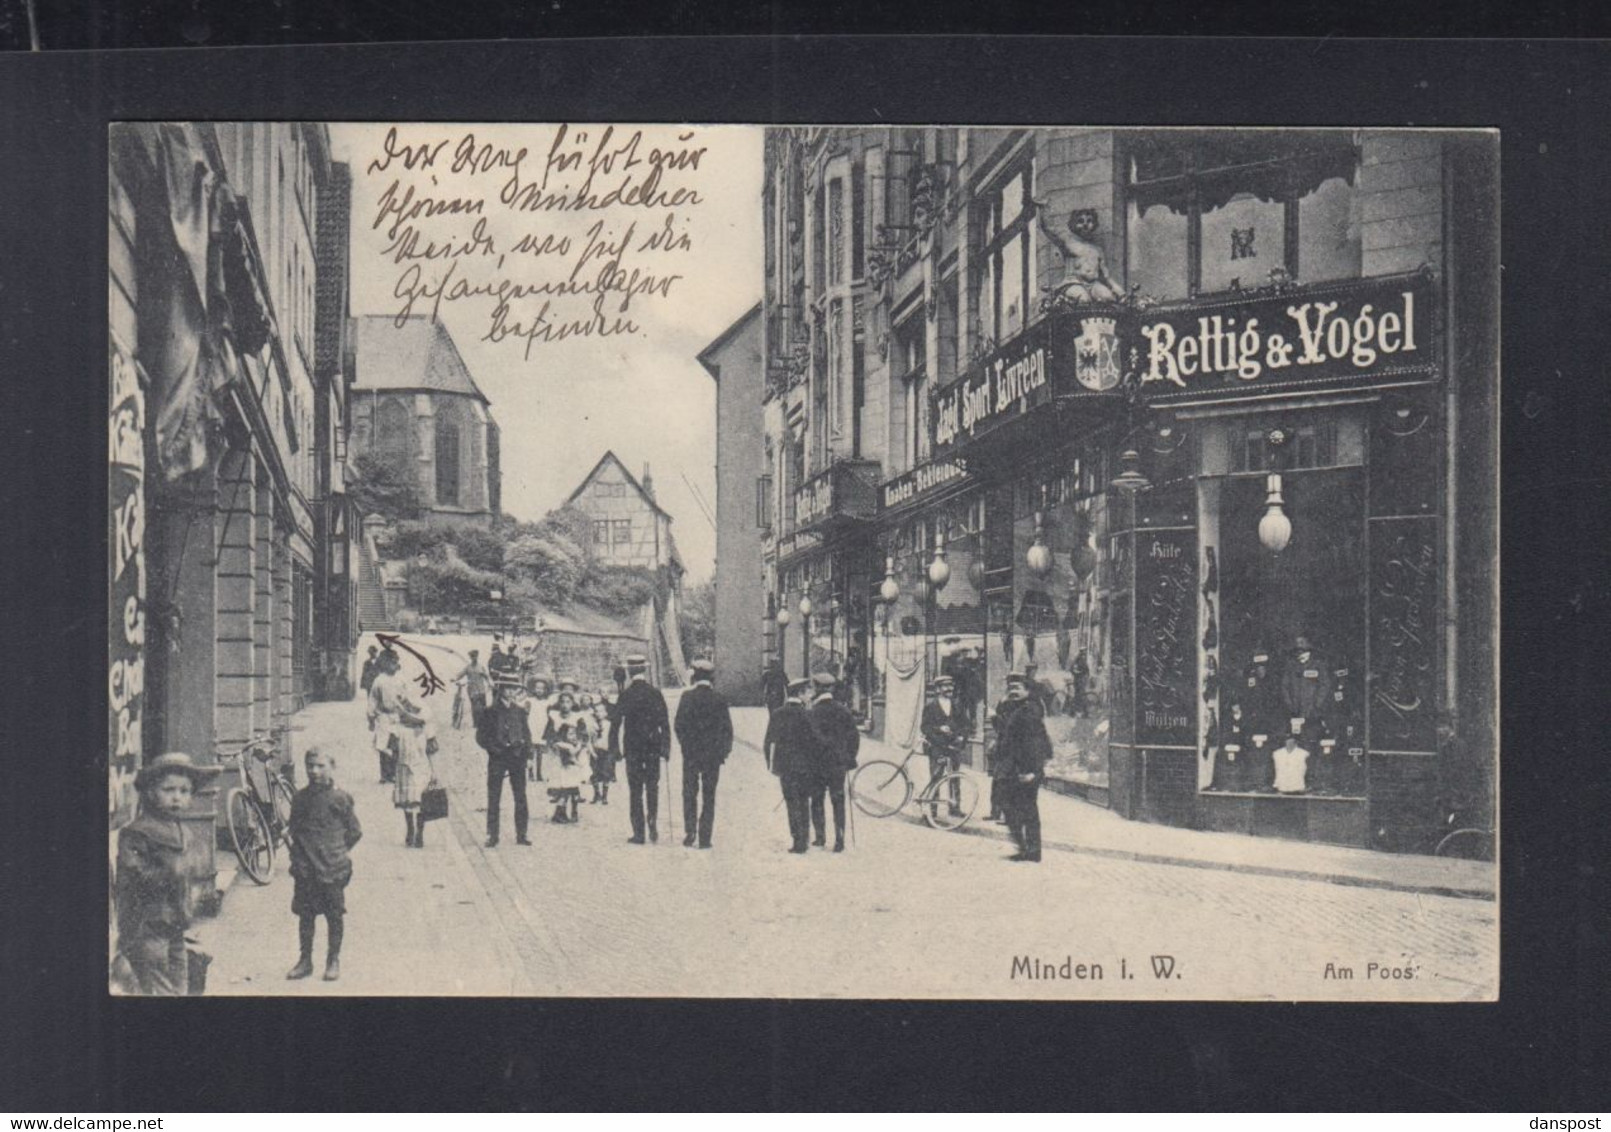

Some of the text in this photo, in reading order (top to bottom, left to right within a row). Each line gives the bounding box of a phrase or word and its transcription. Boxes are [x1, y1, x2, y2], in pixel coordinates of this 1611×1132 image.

[368, 127, 449, 175] Der
[451, 133, 528, 204] Weg
[511, 233, 570, 256] wo
[1141, 292, 1416, 387] Rettig & Vogel
[962, 379, 991, 436] Sport
